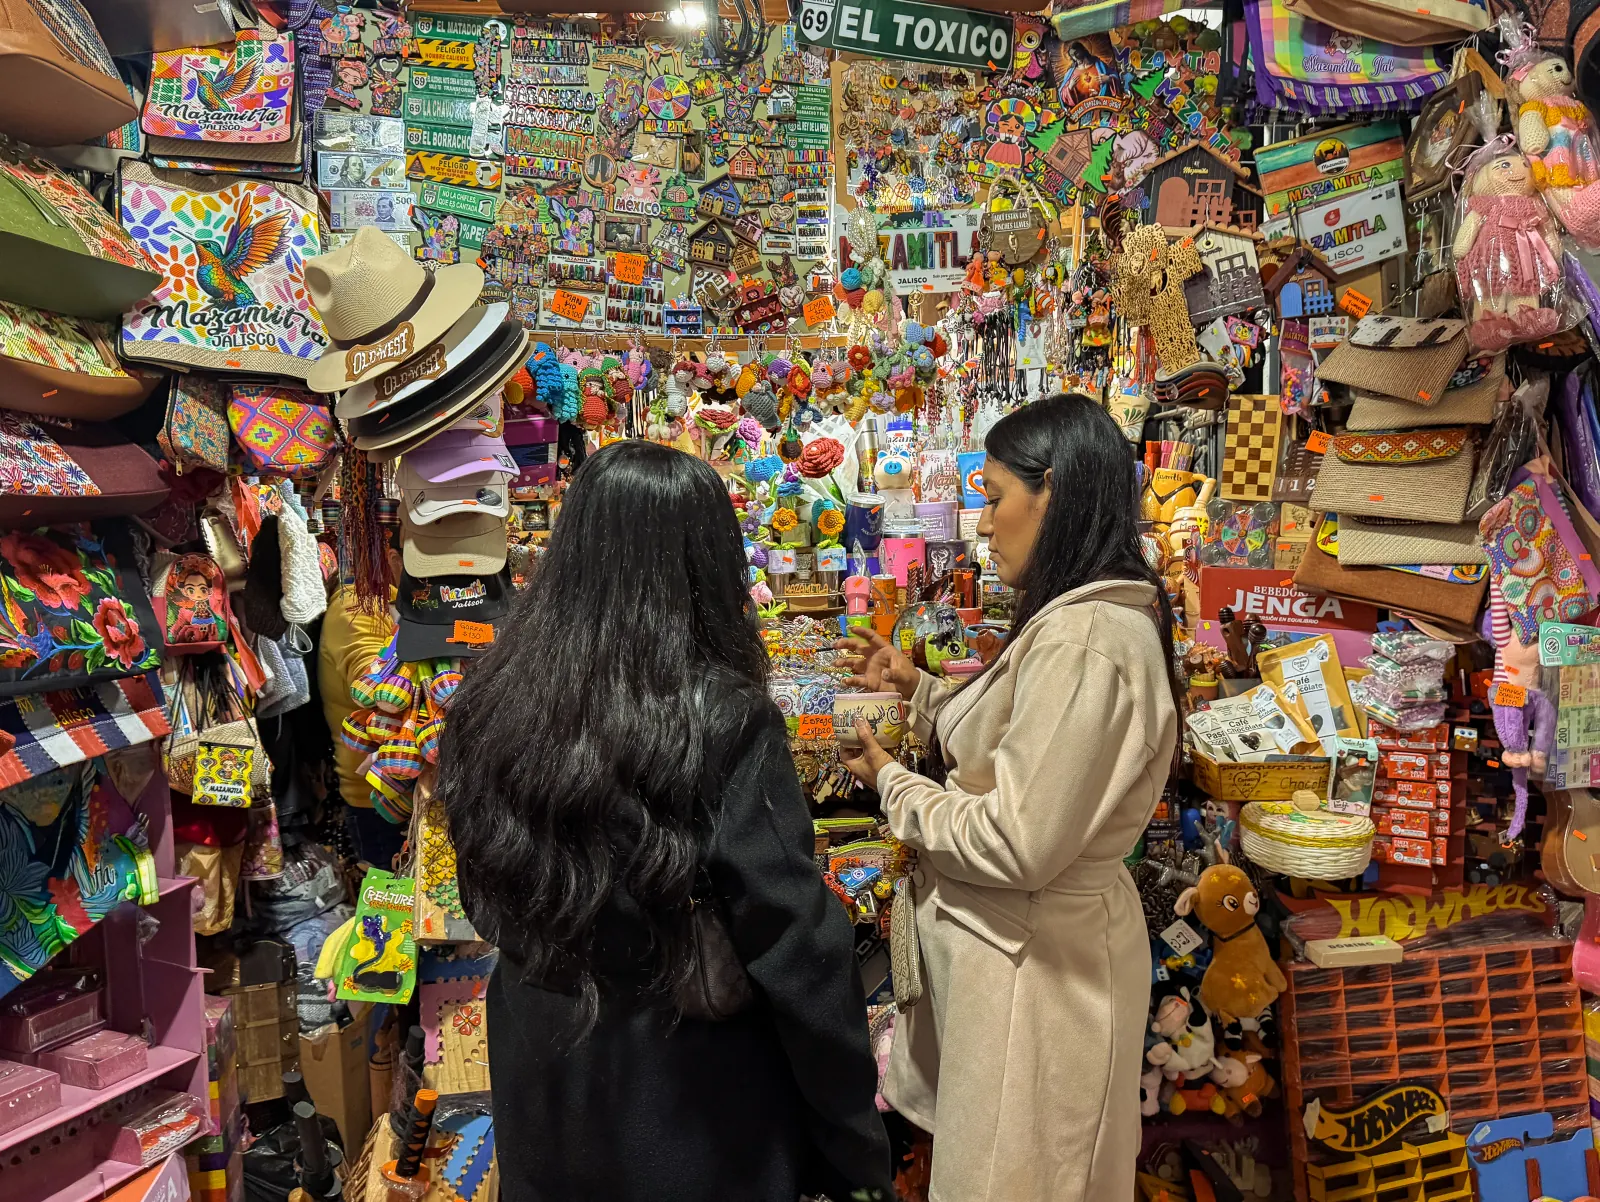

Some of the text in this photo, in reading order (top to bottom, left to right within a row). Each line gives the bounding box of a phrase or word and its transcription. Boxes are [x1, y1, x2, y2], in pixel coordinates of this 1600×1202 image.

[420, 21, 482, 36] 69 EL MATADOR
[802, 5, 1008, 60] 69 EL TOXICO
[436, 46, 466, 54] PELIGRO
[511, 39, 588, 58] MAZAMITLA
[1369, 55, 1395, 77] Jal
[414, 77, 426, 86] 69
[159, 103, 280, 124] Mazamitla
[409, 99, 431, 116] 69 LA
[1137, 105, 1179, 144] MAZAMITLA
[1137, 120, 1168, 146] JALISCO
[409, 133, 420, 142] 69
[423, 131, 431, 145] EL
[438, 160, 469, 170] PELIGRO
[1032, 158, 1078, 196] MAZAMITLA
[1287, 166, 1384, 204] MAZAMITLA
[1033, 173, 1067, 200] JALISCO
[395, 196, 412, 205] 500
[439, 198, 448, 206] QUE
[449, 200, 455, 208] ES
[1310, 214, 1387, 252] ZAMITLA
[620, 256, 642, 267] IMAN
[1327, 244, 1364, 263] LISCO
[897, 276, 928, 285] JALISCO
[561, 290, 583, 305] IMAN
[608, 283, 663, 305] MAZAMITLA
[806, 299, 831, 312] IMAN
[141, 299, 327, 347] Mazamitla
[607, 305, 662, 327] MAZAMITLA
[211, 333, 276, 348] JALISCO
[1226, 588, 1345, 620] JENGA
[1296, 675, 1310, 686] afé
[1498, 686, 1524, 697] CHANGO
[1560, 684, 1570, 701] 100
[53, 707, 96, 729] Jalisco
[1228, 718, 1249, 728] Café
[1226, 722, 1264, 735] Chocolate
[1558, 727, 1568, 745] 200
[1557, 773, 1566, 788] 500
[1327, 941, 1376, 949] DOMINO
